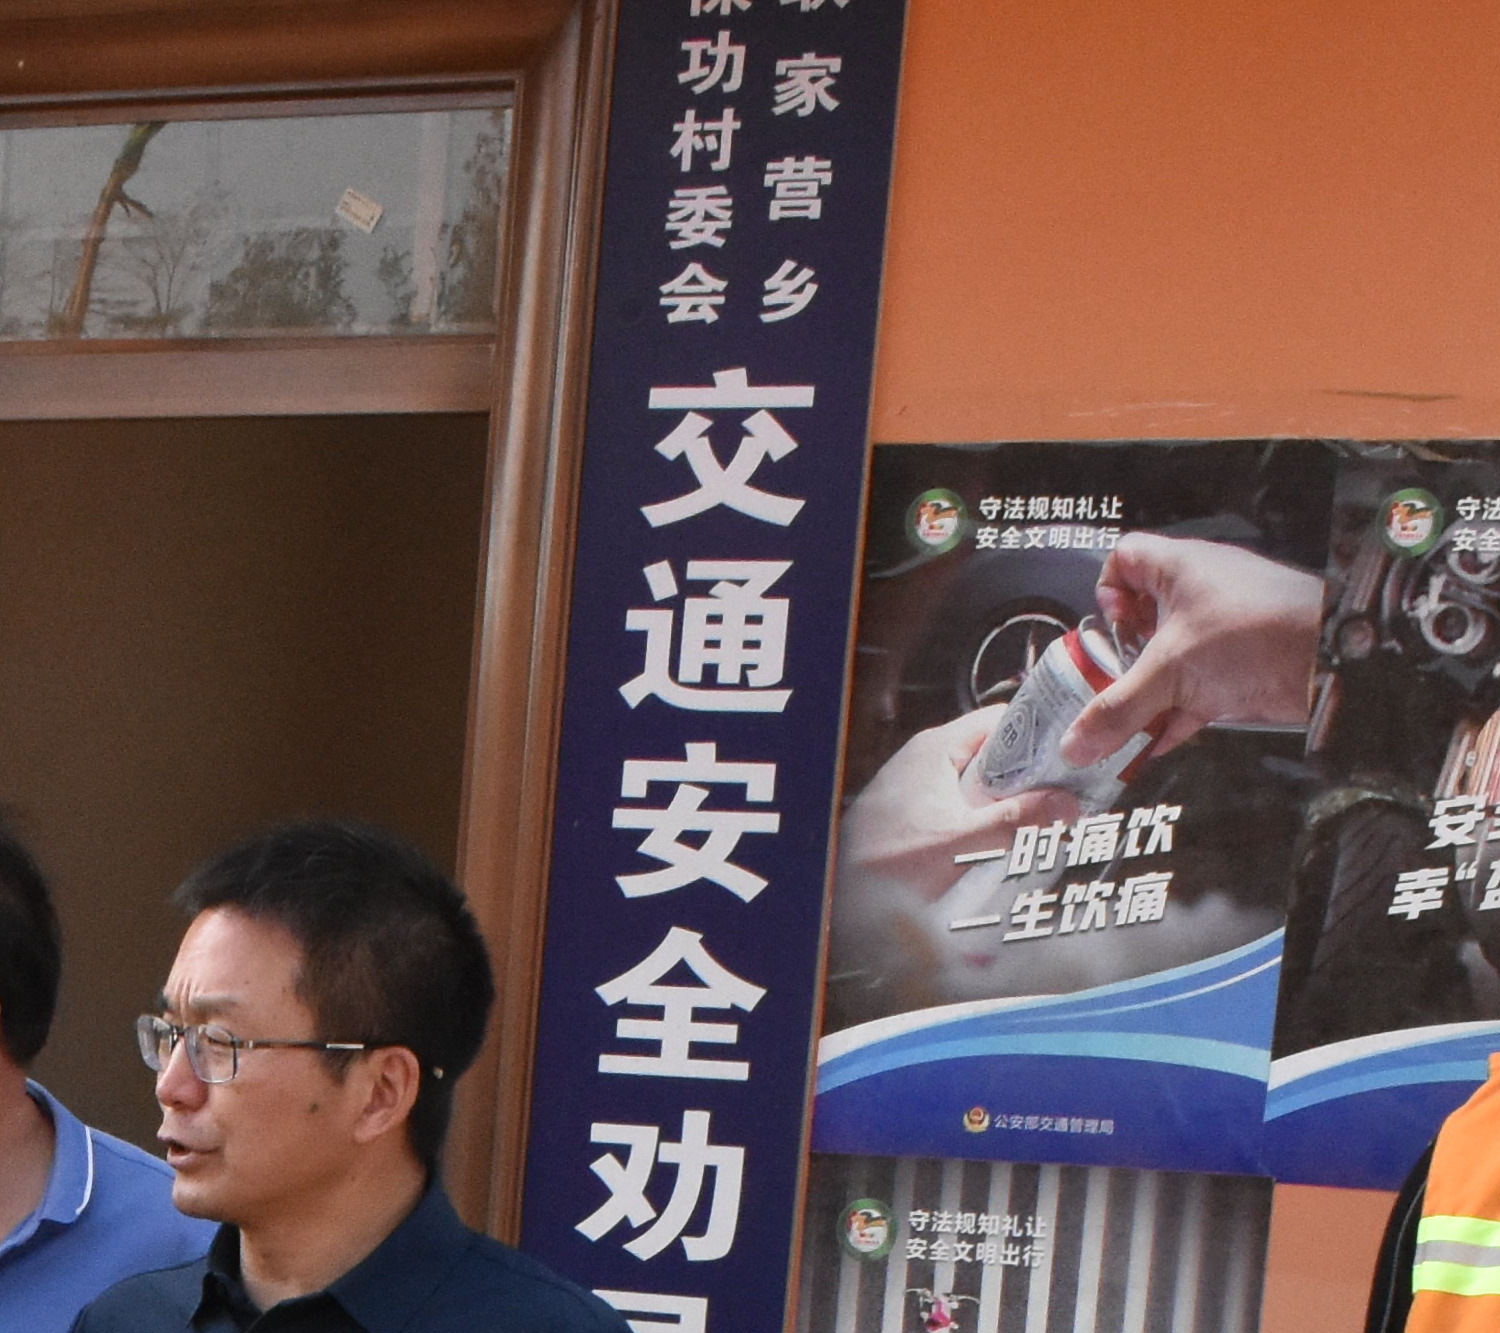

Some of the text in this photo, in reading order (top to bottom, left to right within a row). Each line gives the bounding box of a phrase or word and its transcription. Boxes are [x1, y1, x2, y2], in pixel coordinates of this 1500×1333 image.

[658, 0, 751, 324] 功村委会
[978, 495, 1123, 520] 守法规知礼让
[975, 525, 1121, 550] 安全文明出行
[952, 804, 1182, 877] 一时痛饮
[948, 871, 1175, 943] 一生饮痛
[994, 1114, 1115, 1135] 公安部交通管理局
[907, 1209, 1047, 1239] 守法规知礼让
[904, 1238, 1045, 1268] 安全文明出行
